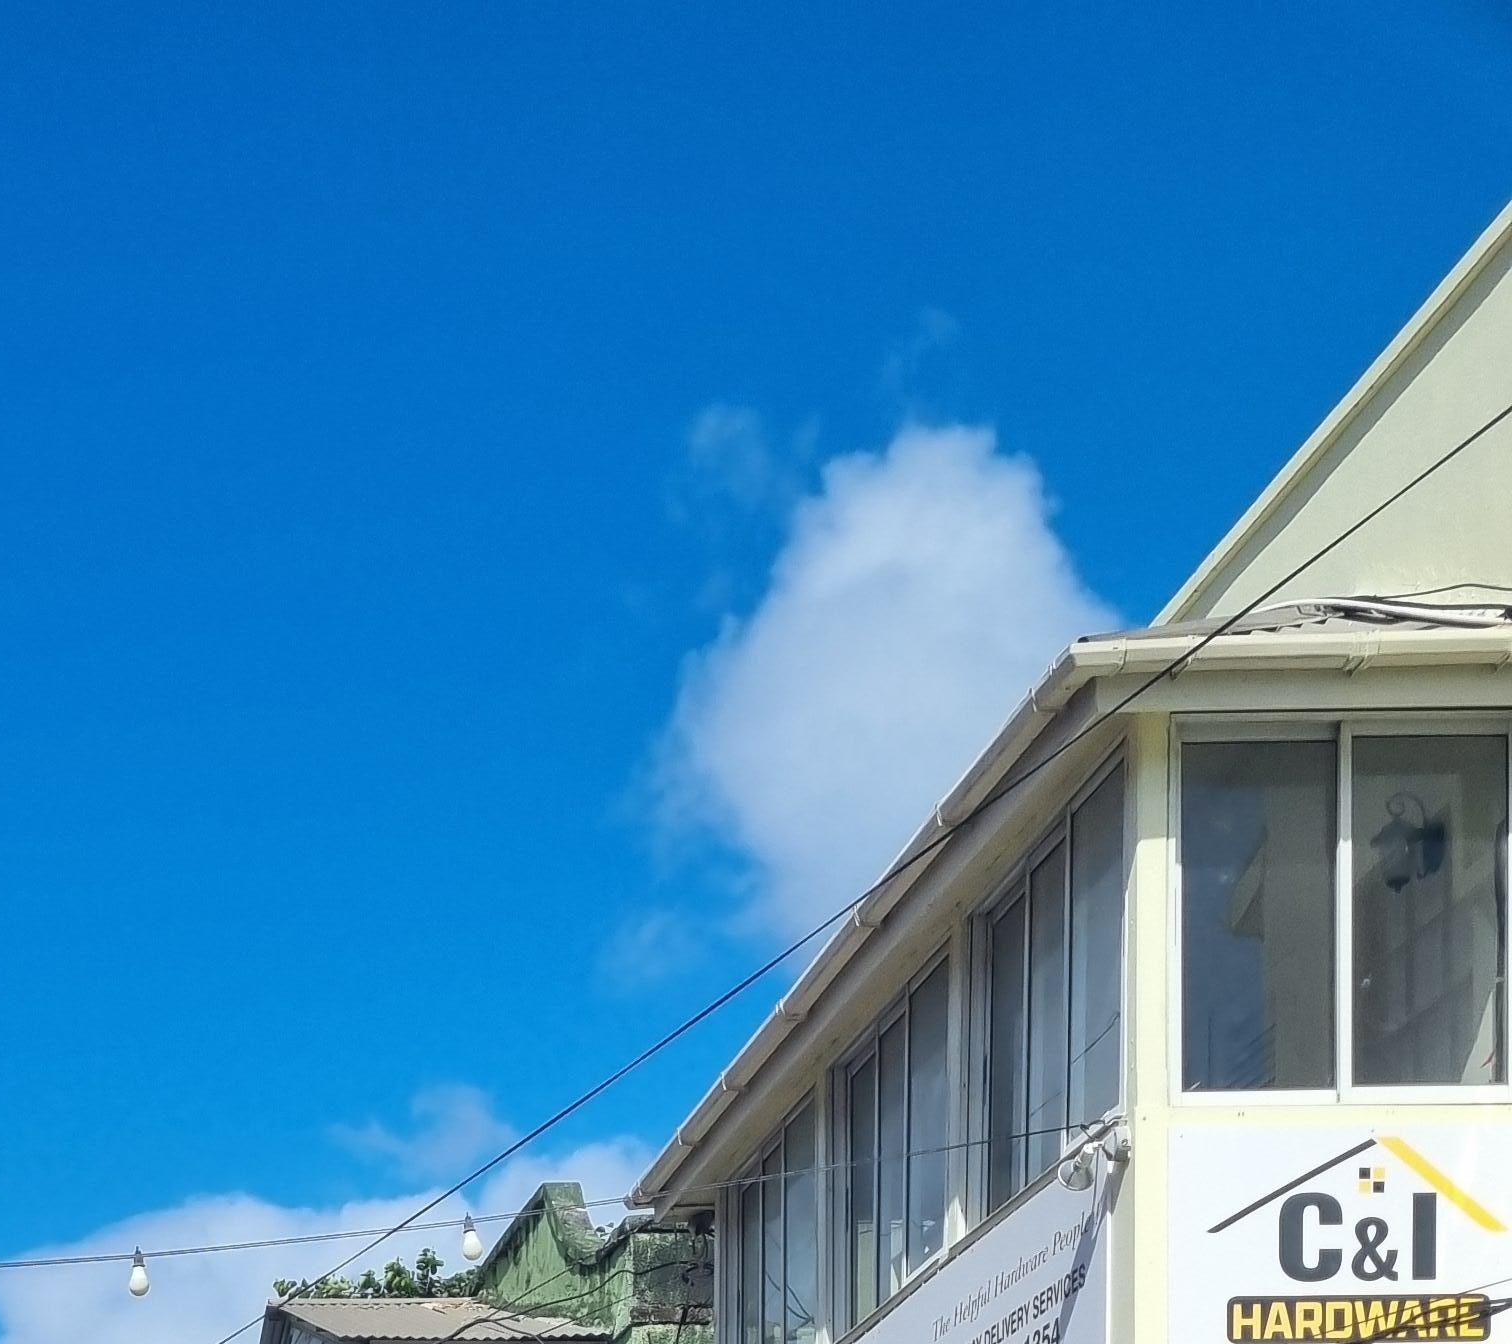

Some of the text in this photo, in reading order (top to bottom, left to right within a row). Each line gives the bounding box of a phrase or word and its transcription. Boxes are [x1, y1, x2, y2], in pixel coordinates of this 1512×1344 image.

[932, 1318, 951, 1342] The
[954, 1280, 991, 1328] Helpful
[994, 1247, 1049, 1299] Hardware
[1032, 1263, 1086, 1320] SERVICES
[1233, 1297, 1485, 1340] HARDWARE
